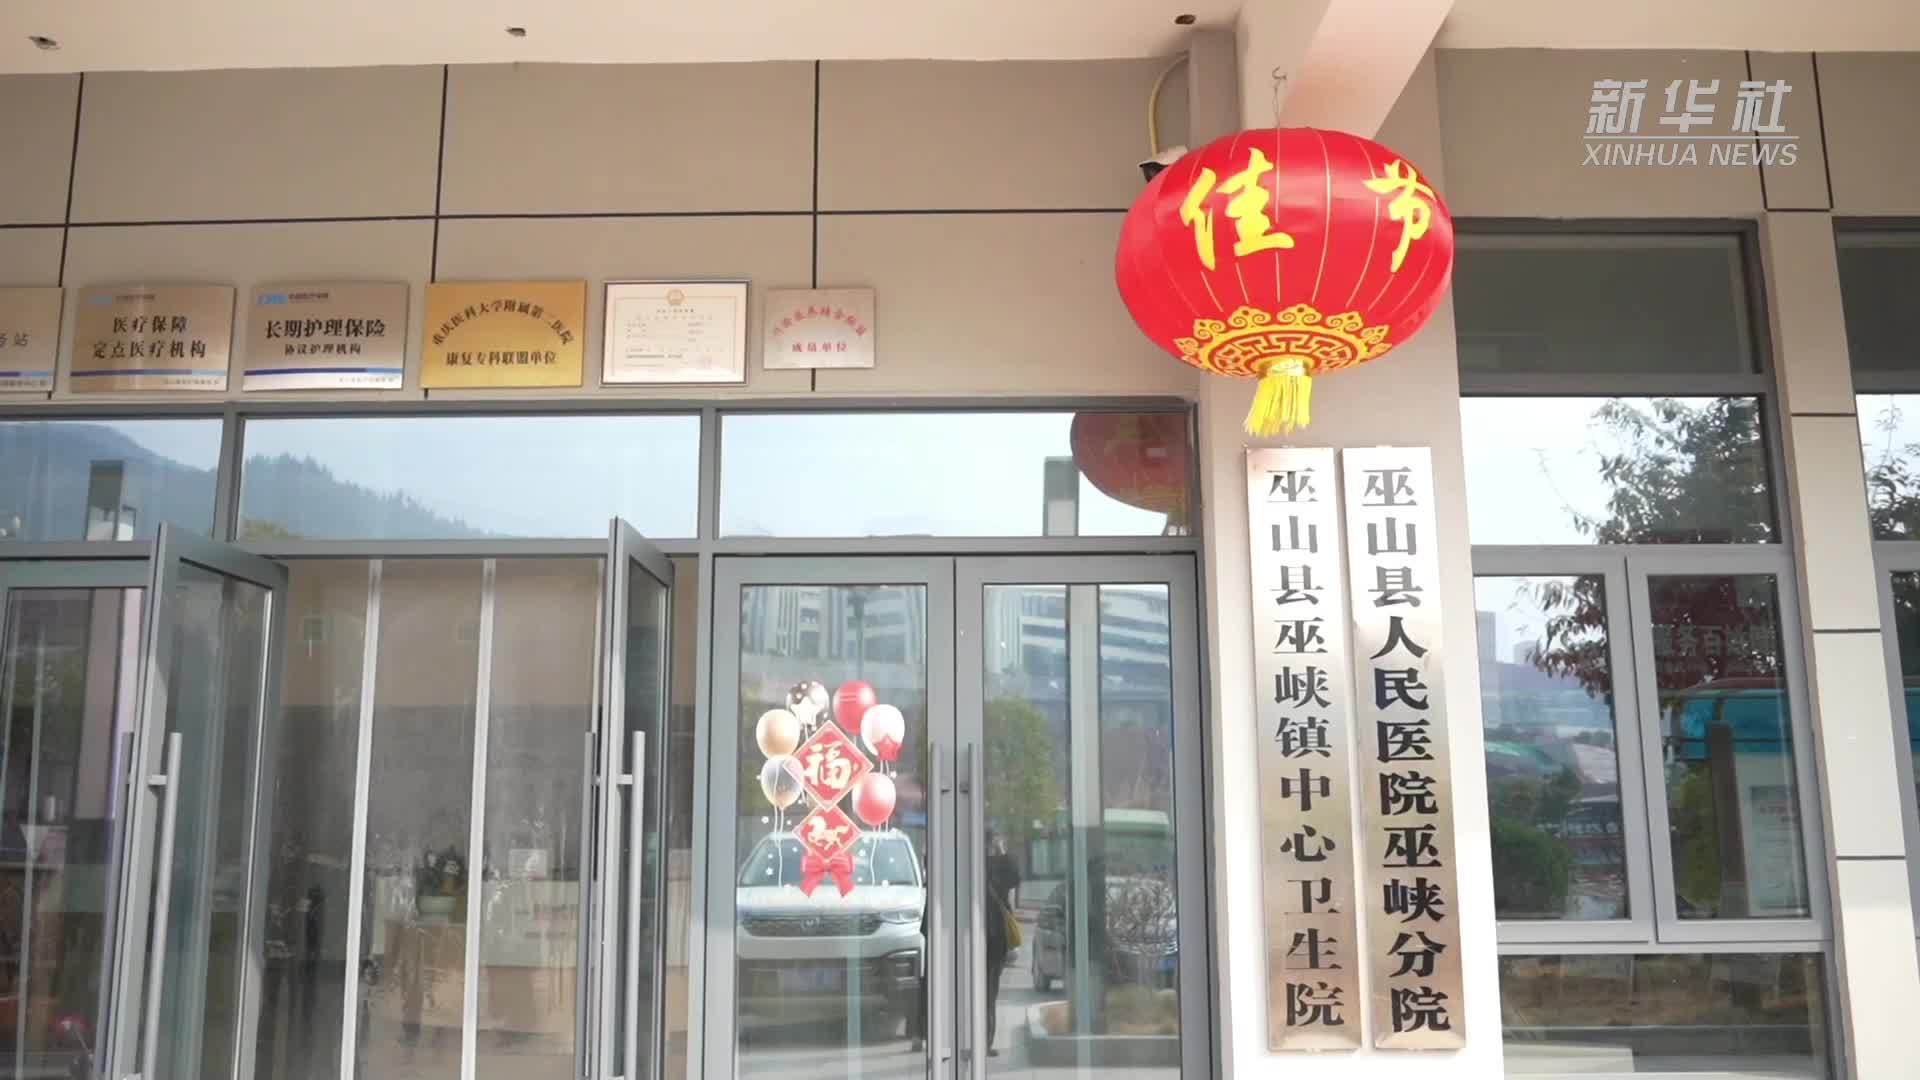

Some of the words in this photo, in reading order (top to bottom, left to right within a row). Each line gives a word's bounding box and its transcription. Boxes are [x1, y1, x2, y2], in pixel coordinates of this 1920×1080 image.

[113, 315, 188, 334] 医疗保障
[265, 318, 386, 339] 长期护理保险
[92, 339, 207, 359] 定点医疗机构
[284, 342, 362, 356] 协议护理机构
[446, 350, 557, 366] 康复专科联盟单位
[1265, 467, 1345, 1029] 巫山县巫峡镇中心卫生院
[1360, 465, 1452, 1034] 巫山县人民医院巫峡分院
[803, 742, 853, 790] 福
